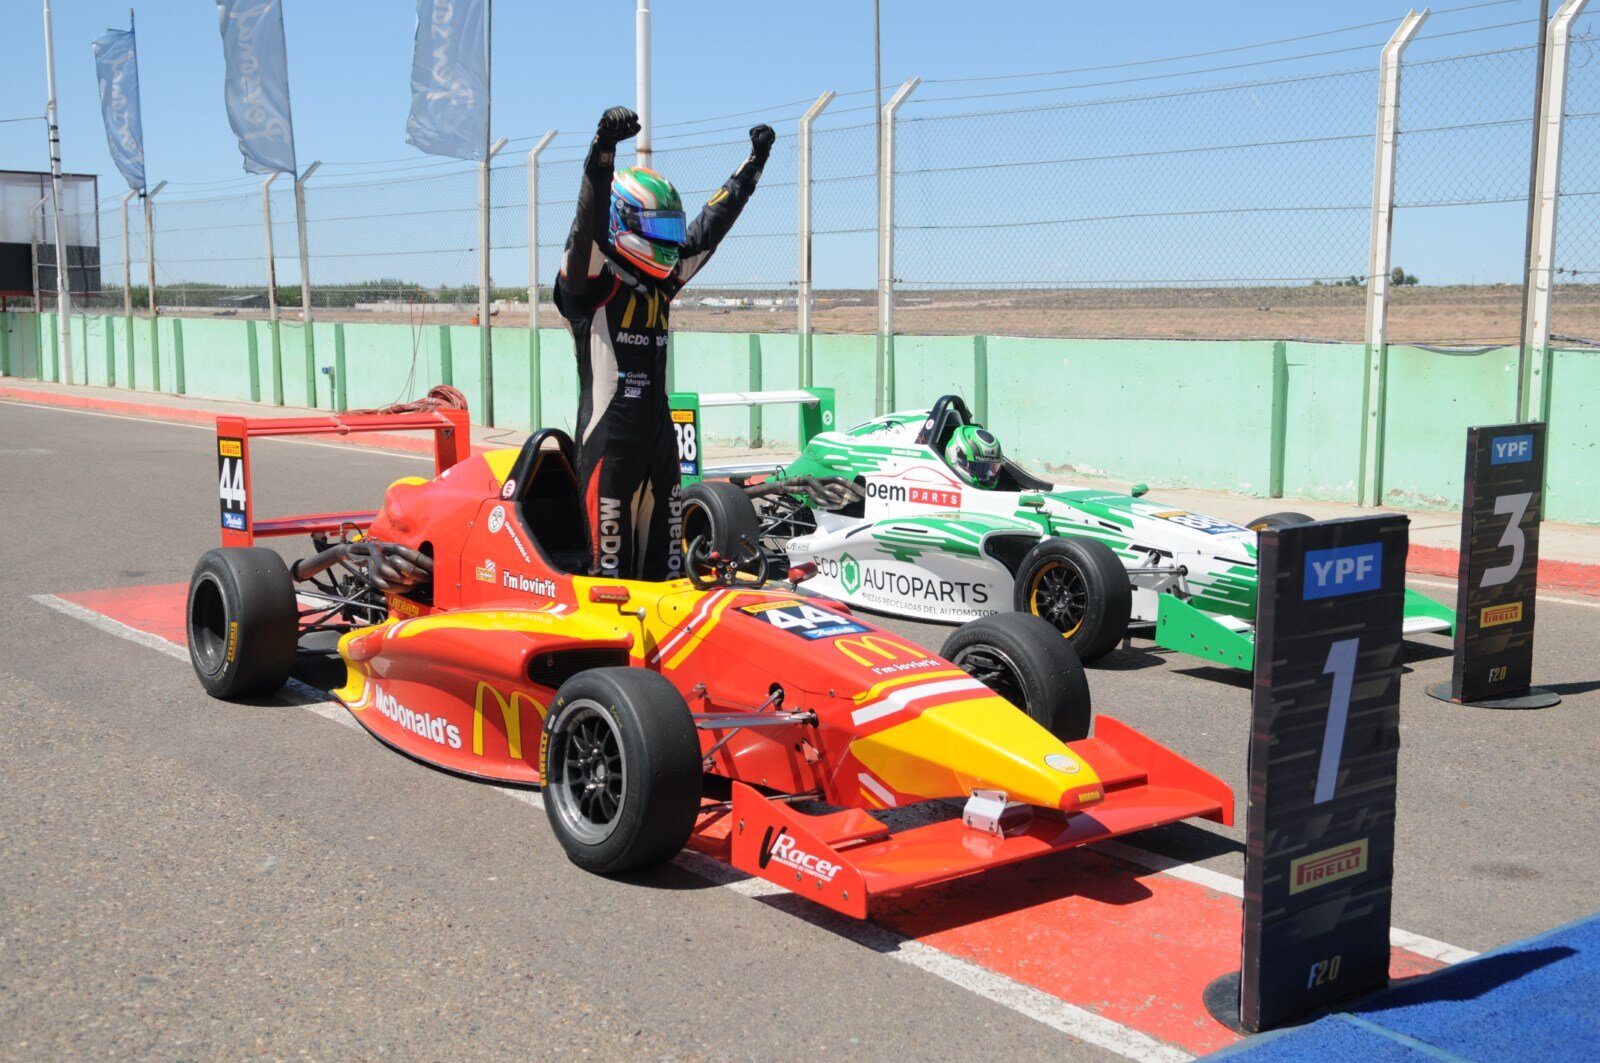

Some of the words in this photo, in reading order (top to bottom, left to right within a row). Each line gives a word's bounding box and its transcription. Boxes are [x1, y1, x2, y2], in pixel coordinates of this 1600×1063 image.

[625, 378, 651, 387] Moggia
[1495, 440, 1529, 458] YPF
[219, 457, 247, 511] 44
[866, 482, 906, 502] oem
[912, 490, 958, 505] PARTS
[1479, 492, 1534, 588] 3
[503, 570, 518, 589] i'm
[1312, 555, 1374, 587] YPF
[863, 567, 989, 604] AUTOPARTS
[764, 604, 852, 630] 44
[923, 606, 938, 614] DEL
[1483, 605, 1519, 623] PIRELLI
[375, 684, 463, 750] McDonald's
[1313, 638, 1361, 805] 1
[1296, 846, 1362, 886] PIRELLI
